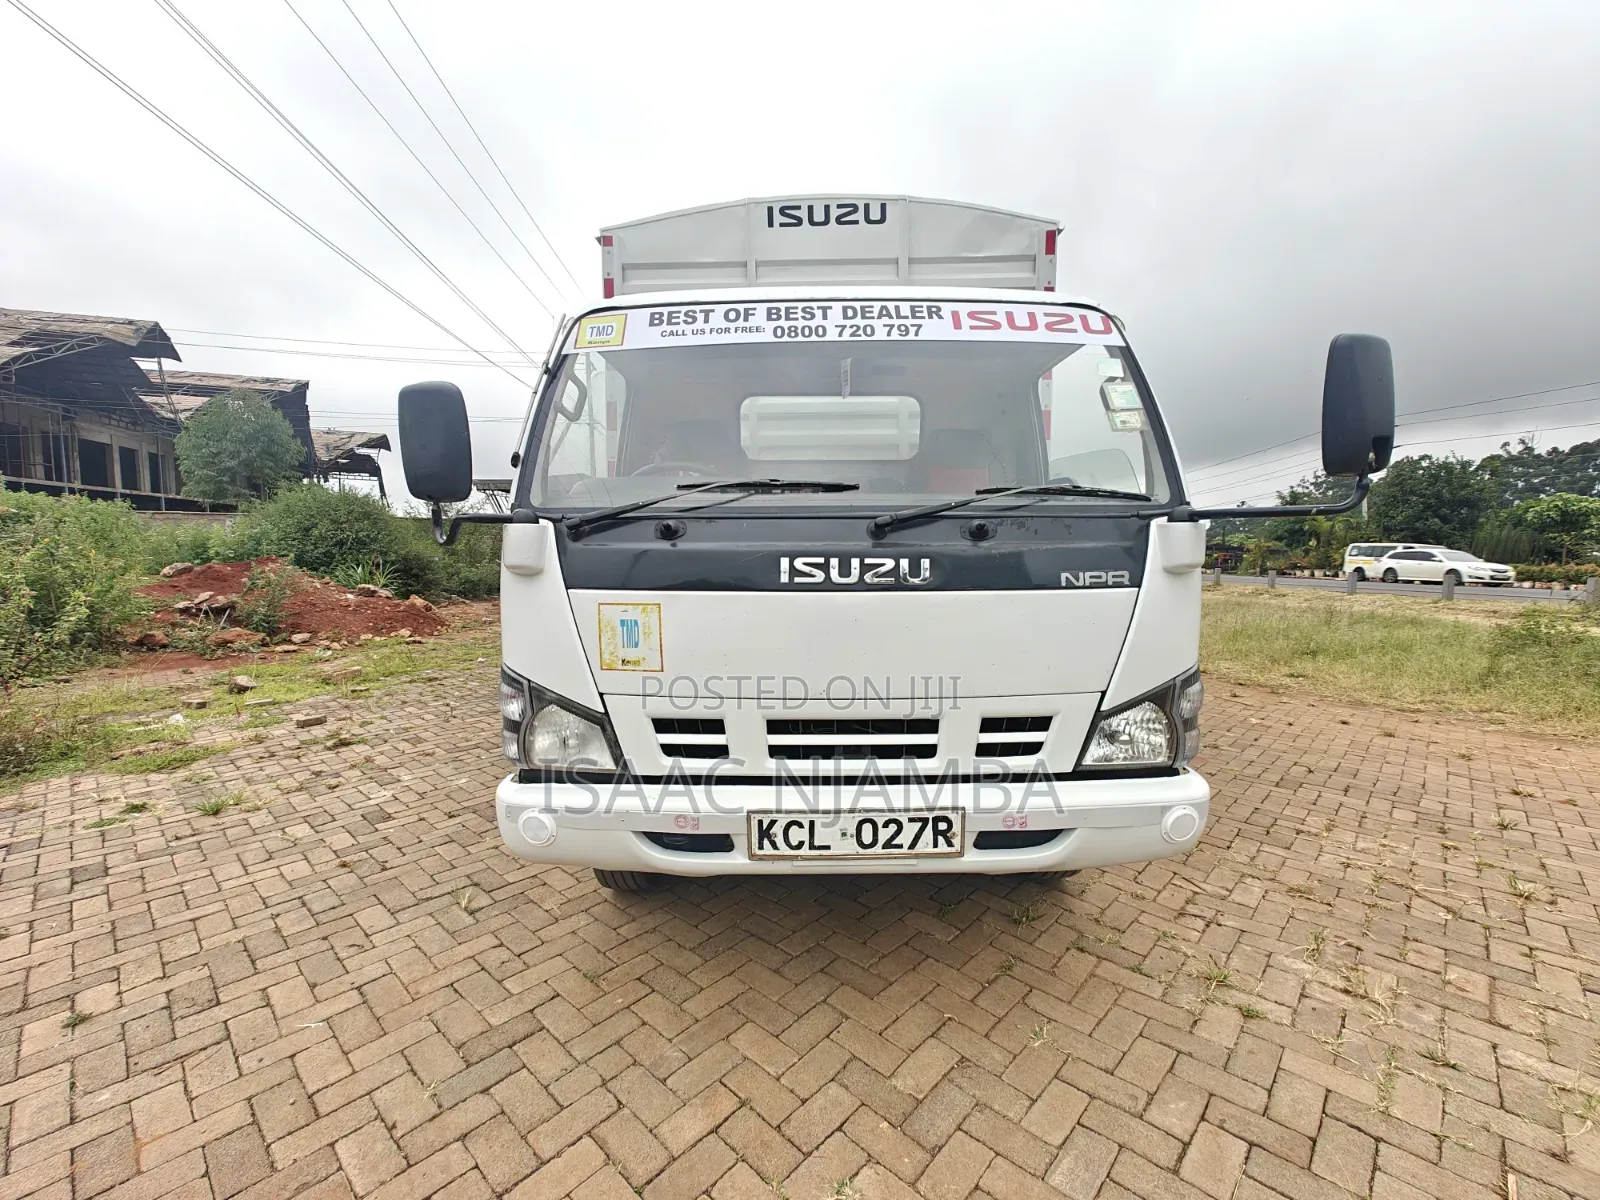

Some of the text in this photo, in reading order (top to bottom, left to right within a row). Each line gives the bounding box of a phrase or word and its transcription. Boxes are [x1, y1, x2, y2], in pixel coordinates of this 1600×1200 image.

[767, 202, 887, 228] ISUZU
[649, 305, 945, 327] BEST OF BEST DEALER
[950, 310, 1113, 335] ISUZU
[589, 324, 614, 338] TMD
[660, 326, 766, 338] CALL US FOR FREE:
[772, 323, 923, 339] 0800 720 797
[780, 557, 931, 585] ISUZU
[1060, 570, 1131, 587] NPR
[619, 618, 640, 649] TMD
[757, 816, 955, 851] KCL 027R
